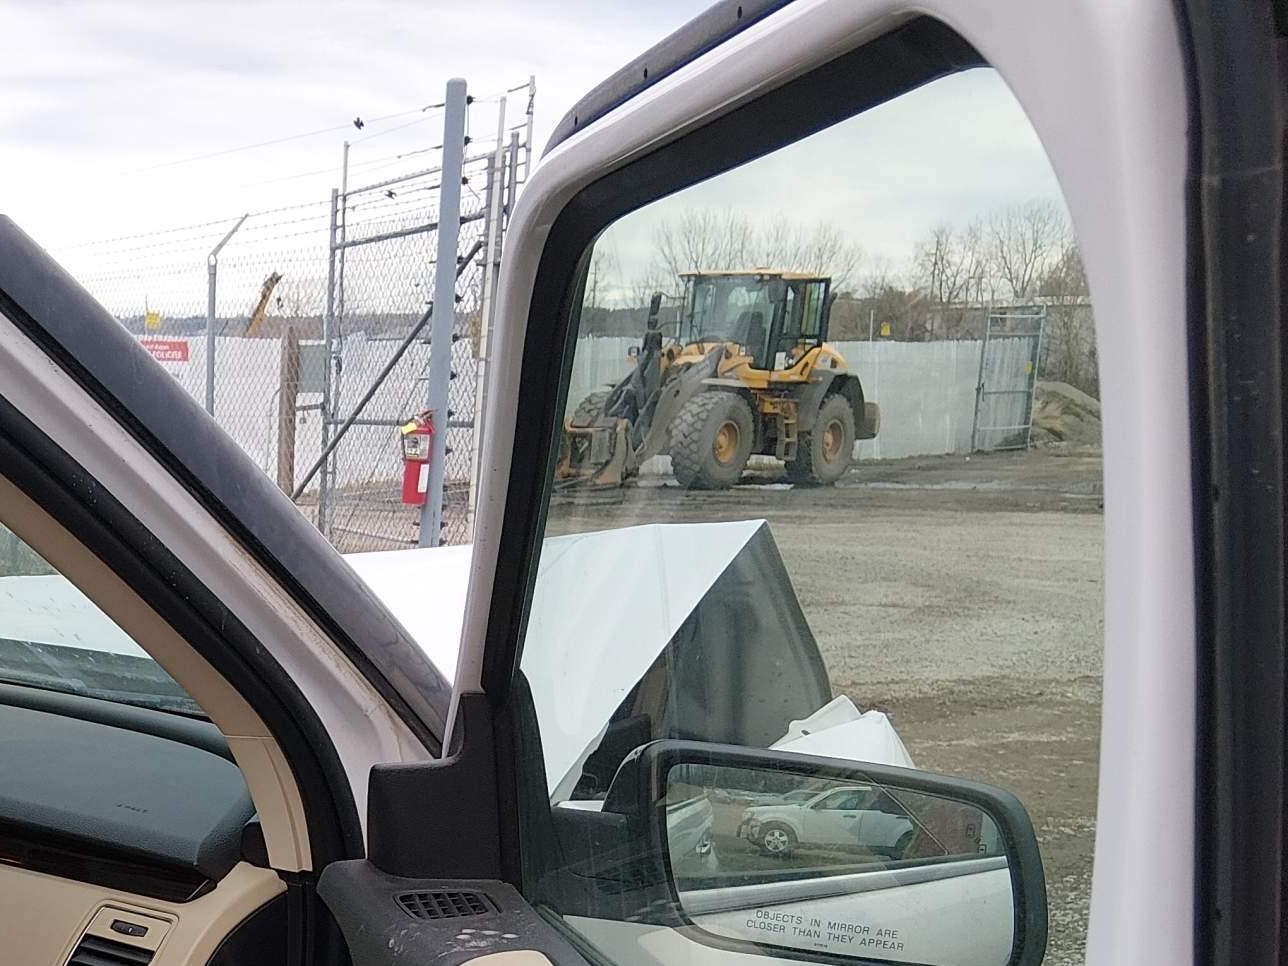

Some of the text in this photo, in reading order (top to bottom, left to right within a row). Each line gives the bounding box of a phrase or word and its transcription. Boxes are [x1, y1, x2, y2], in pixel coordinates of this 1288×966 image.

[746, 919, 905, 951] CLOSER THAN THEY APPEAR
[755, 910, 899, 939] OBJECTS IN MIRROR ARE
